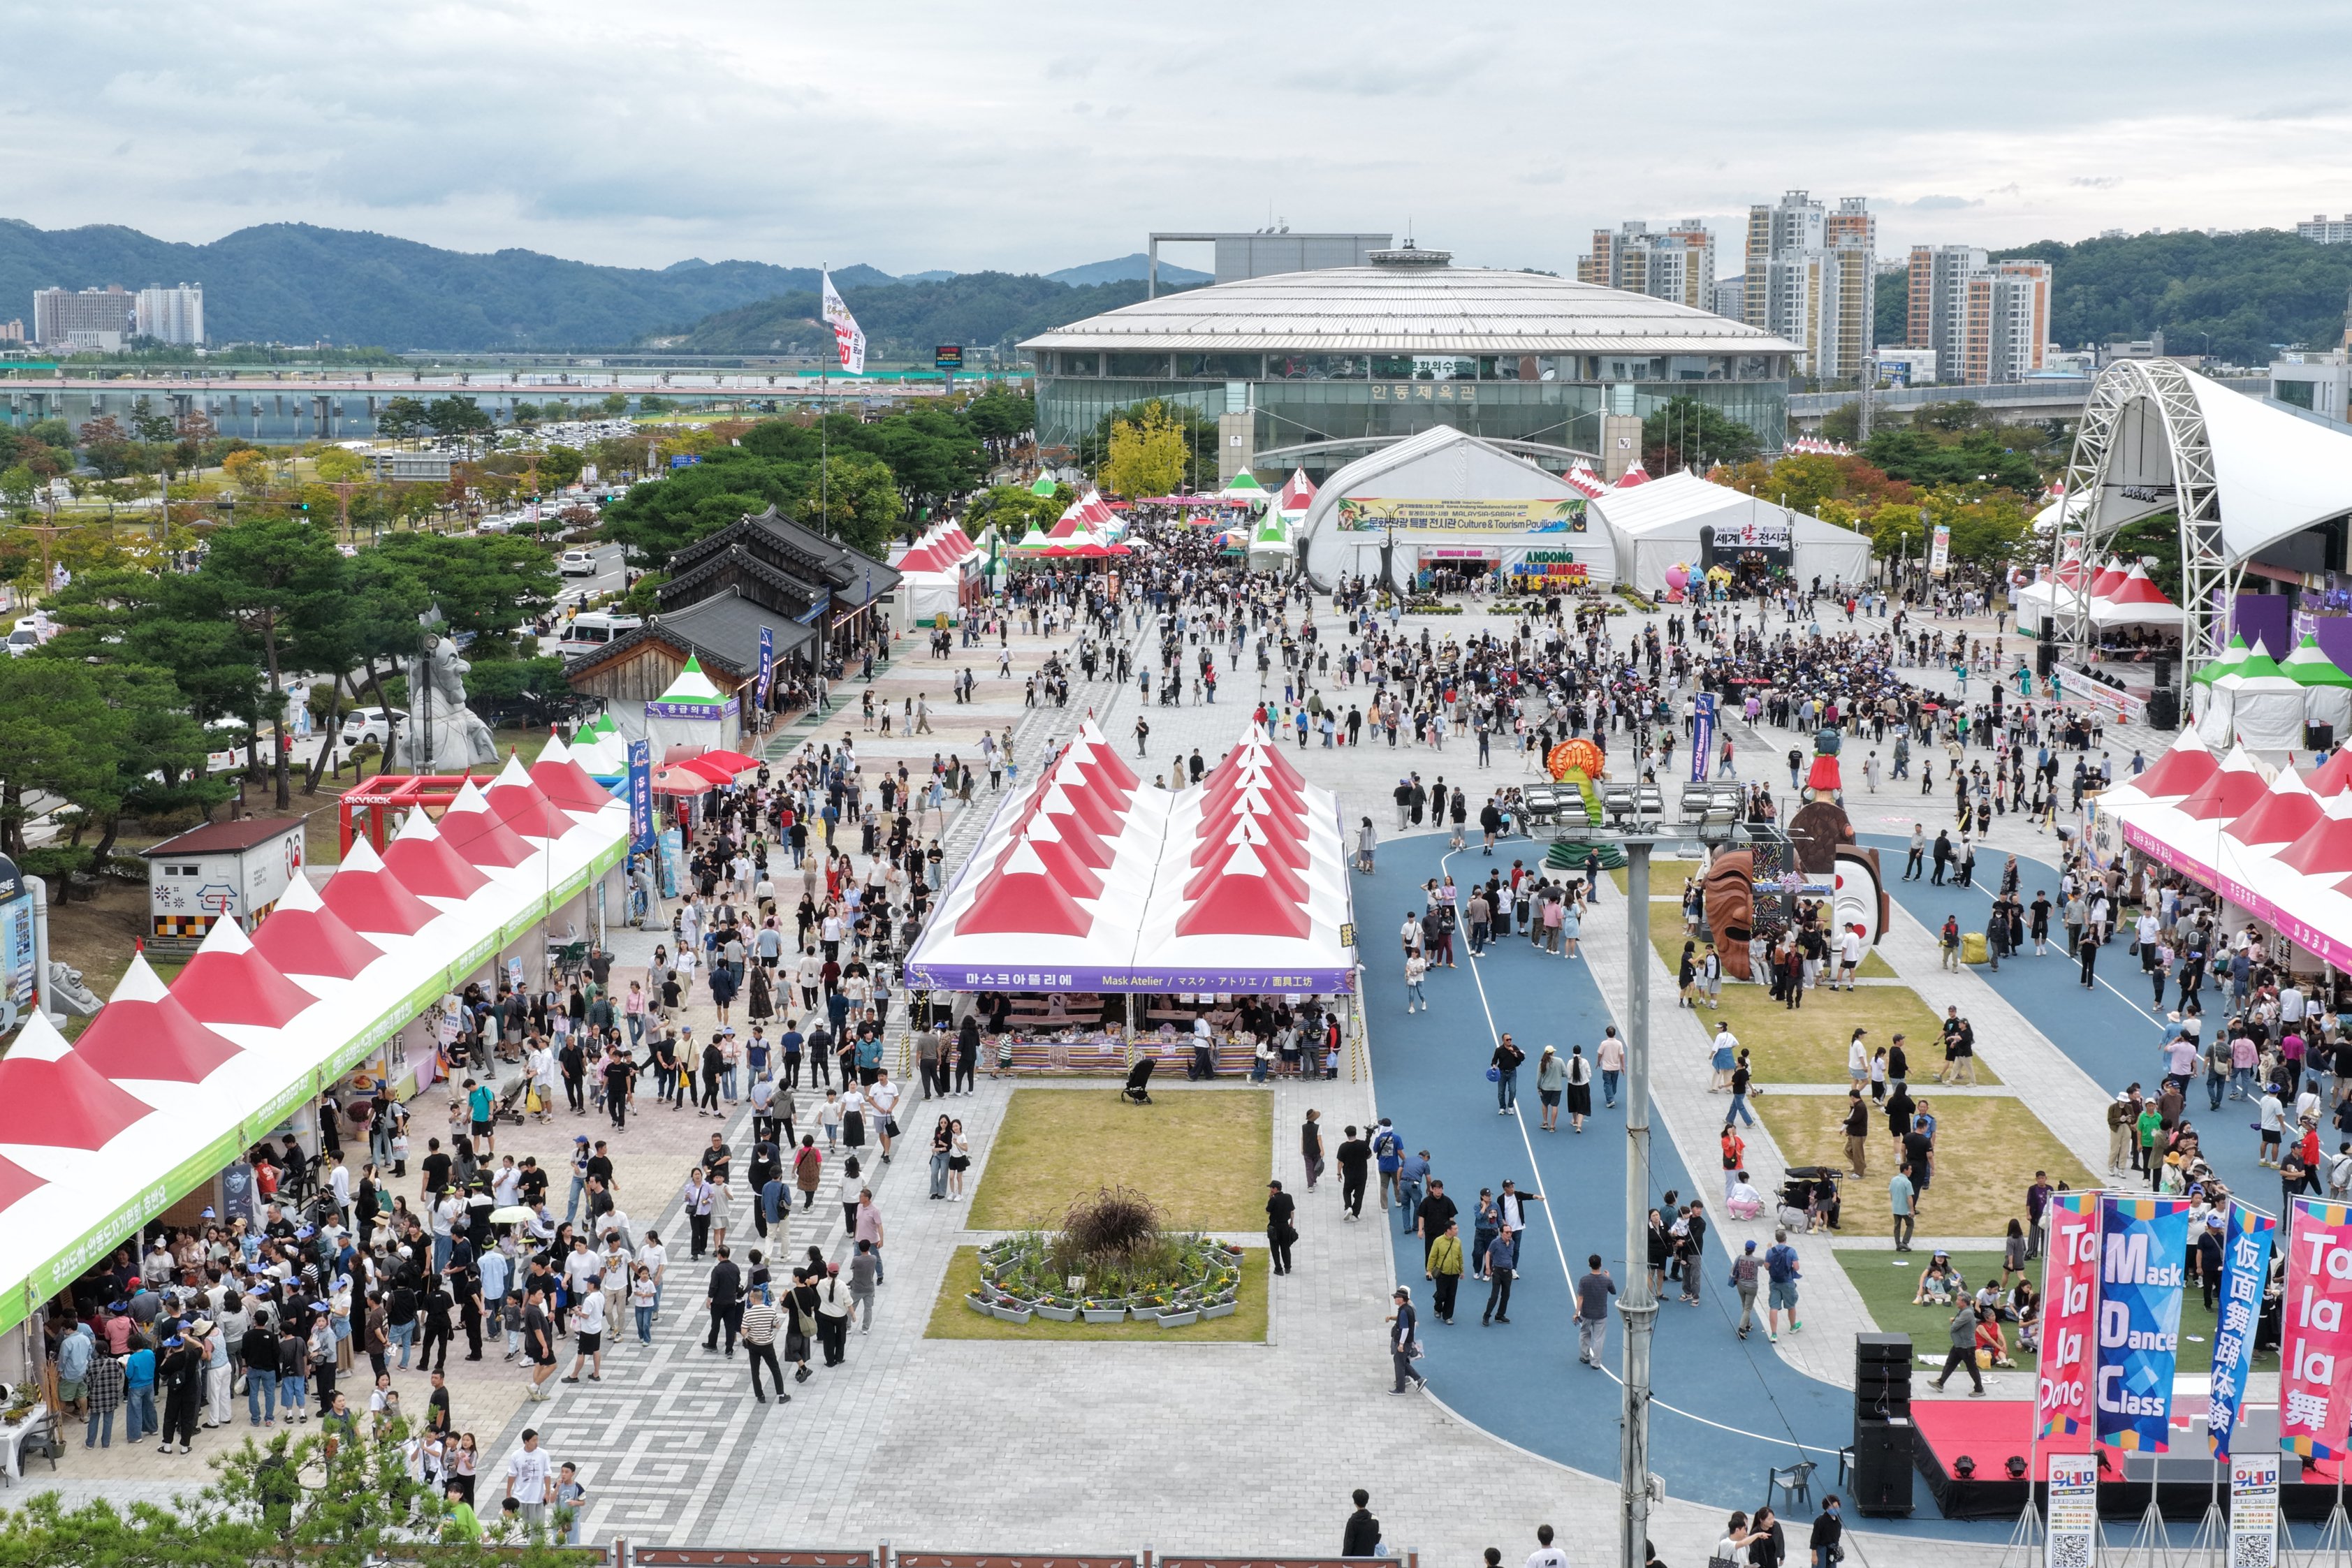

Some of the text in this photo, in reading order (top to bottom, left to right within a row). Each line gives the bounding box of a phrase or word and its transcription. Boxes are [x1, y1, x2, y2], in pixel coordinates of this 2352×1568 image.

[1372, 385, 1475, 400] 안동체육관
[1410, 518, 1427, 529] 특별
[1429, 518, 1456, 529] 전시관
[1457, 519, 1487, 529] Culture
[1488, 519, 1493, 529] &
[1495, 519, 1525, 529] Tourism
[1526, 519, 1557, 529] Pavilion
[1716, 534, 1740, 545] 세계
[1741, 524, 1757, 545] 탈
[1526, 551, 1573, 563] ANDONG
[1547, 564, 1587, 576] DANCE
[668, 704, 710, 715] 응급의료
[344, 796, 391, 805] SKYKICK
[966, 973, 1072, 986] 마스크아뜰리에
[1102, 976, 1129, 986] Mask
[1130, 976, 1163, 986] Atelier
[1178, 976, 1257, 987] マスク・アトリエ
[1272, 976, 1313, 987] 面具工坊
[2105, 1233, 2182, 1287] Mask
[2303, 1232, 2352, 1280] Ta
[2061, 1277, 2089, 1317] la
[2299, 1285, 2343, 1332] la
[2100, 1299, 2177, 1351] Dance
[2056, 1328, 2082, 1368] la
[2292, 1338, 2335, 1386] la
[2098, 1365, 2165, 1416] Class
[2286, 1389, 2329, 1431] 舞
